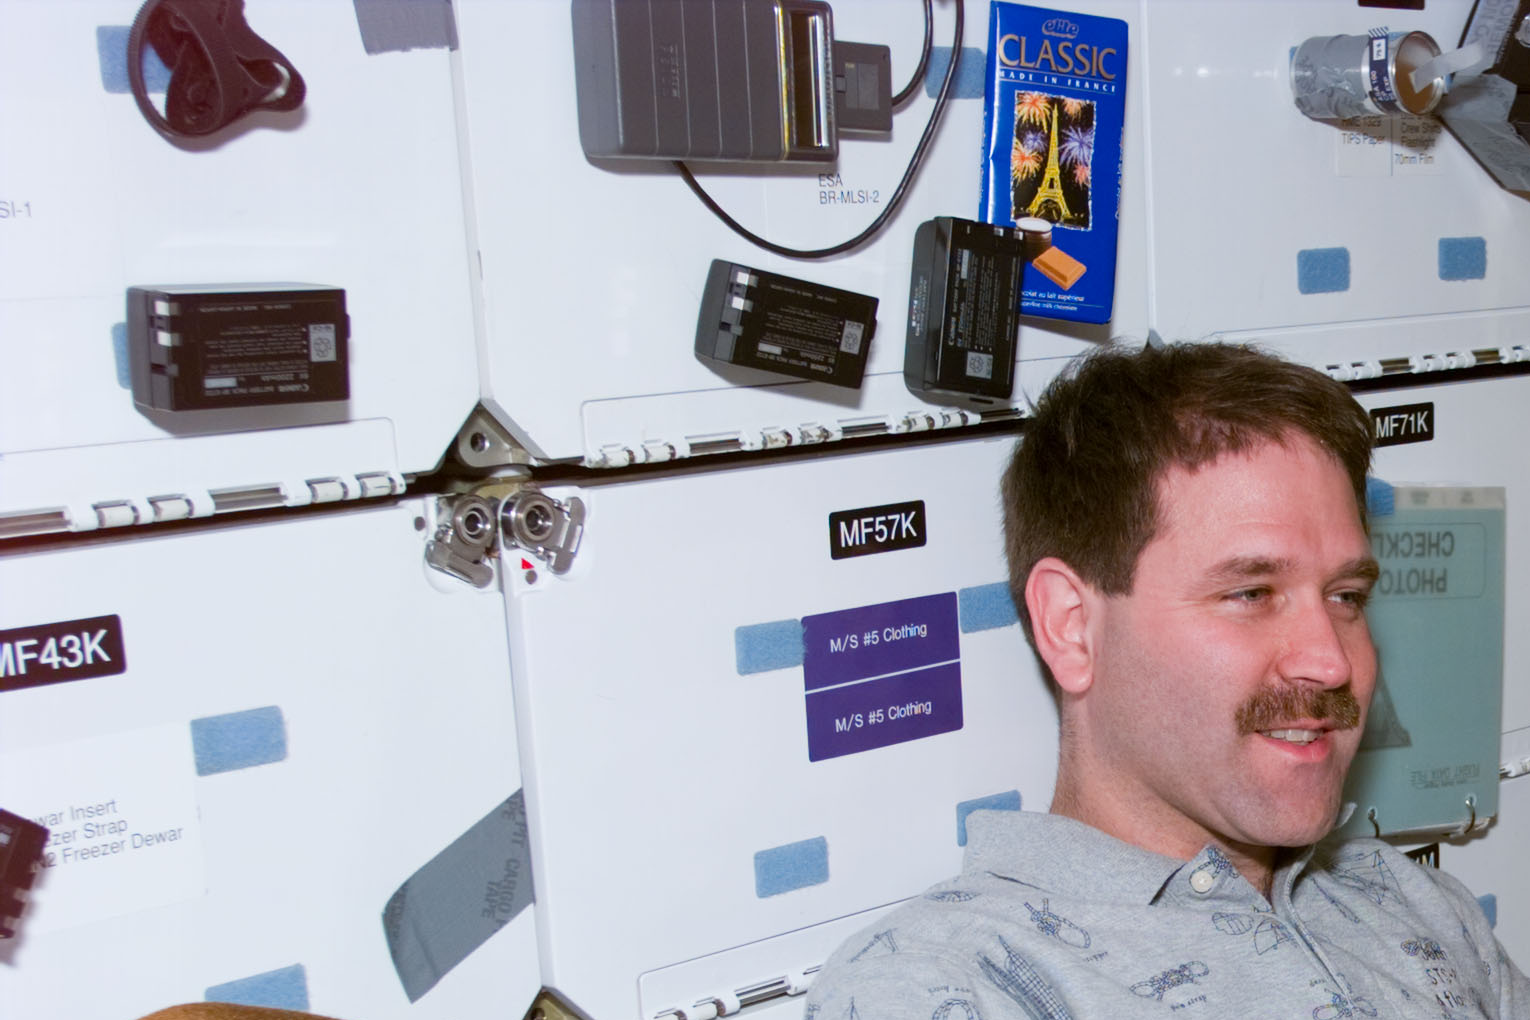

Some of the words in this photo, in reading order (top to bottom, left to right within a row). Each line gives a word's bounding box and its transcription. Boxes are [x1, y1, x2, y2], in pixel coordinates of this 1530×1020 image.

[999, 34, 1118, 80] CLASSIC
[1044, 75, 1058, 85] IN
[1067, 78, 1117, 93] FRANCE
[818, 172, 843, 188] ESA
[819, 190, 880, 206] BR-MLSI-2
[1375, 408, 1429, 438] MF71K
[838, 510, 918, 549] MF57K
[829, 633, 859, 653] M/S
[862, 629, 880, 647] #5
[882, 621, 928, 644] Clothing
[834, 713, 865, 733] M/S
[868, 708, 885, 725] #5
[887, 699, 932, 722] Clothing
[70, 799, 118, 822] Insert
[62, 838, 126, 864] Freezer
[131, 826, 184, 850] Dewar
[83, 818, 128, 840] Strap
[481, 880, 502, 919] TAPE
[498, 857, 521, 915] CARGO
